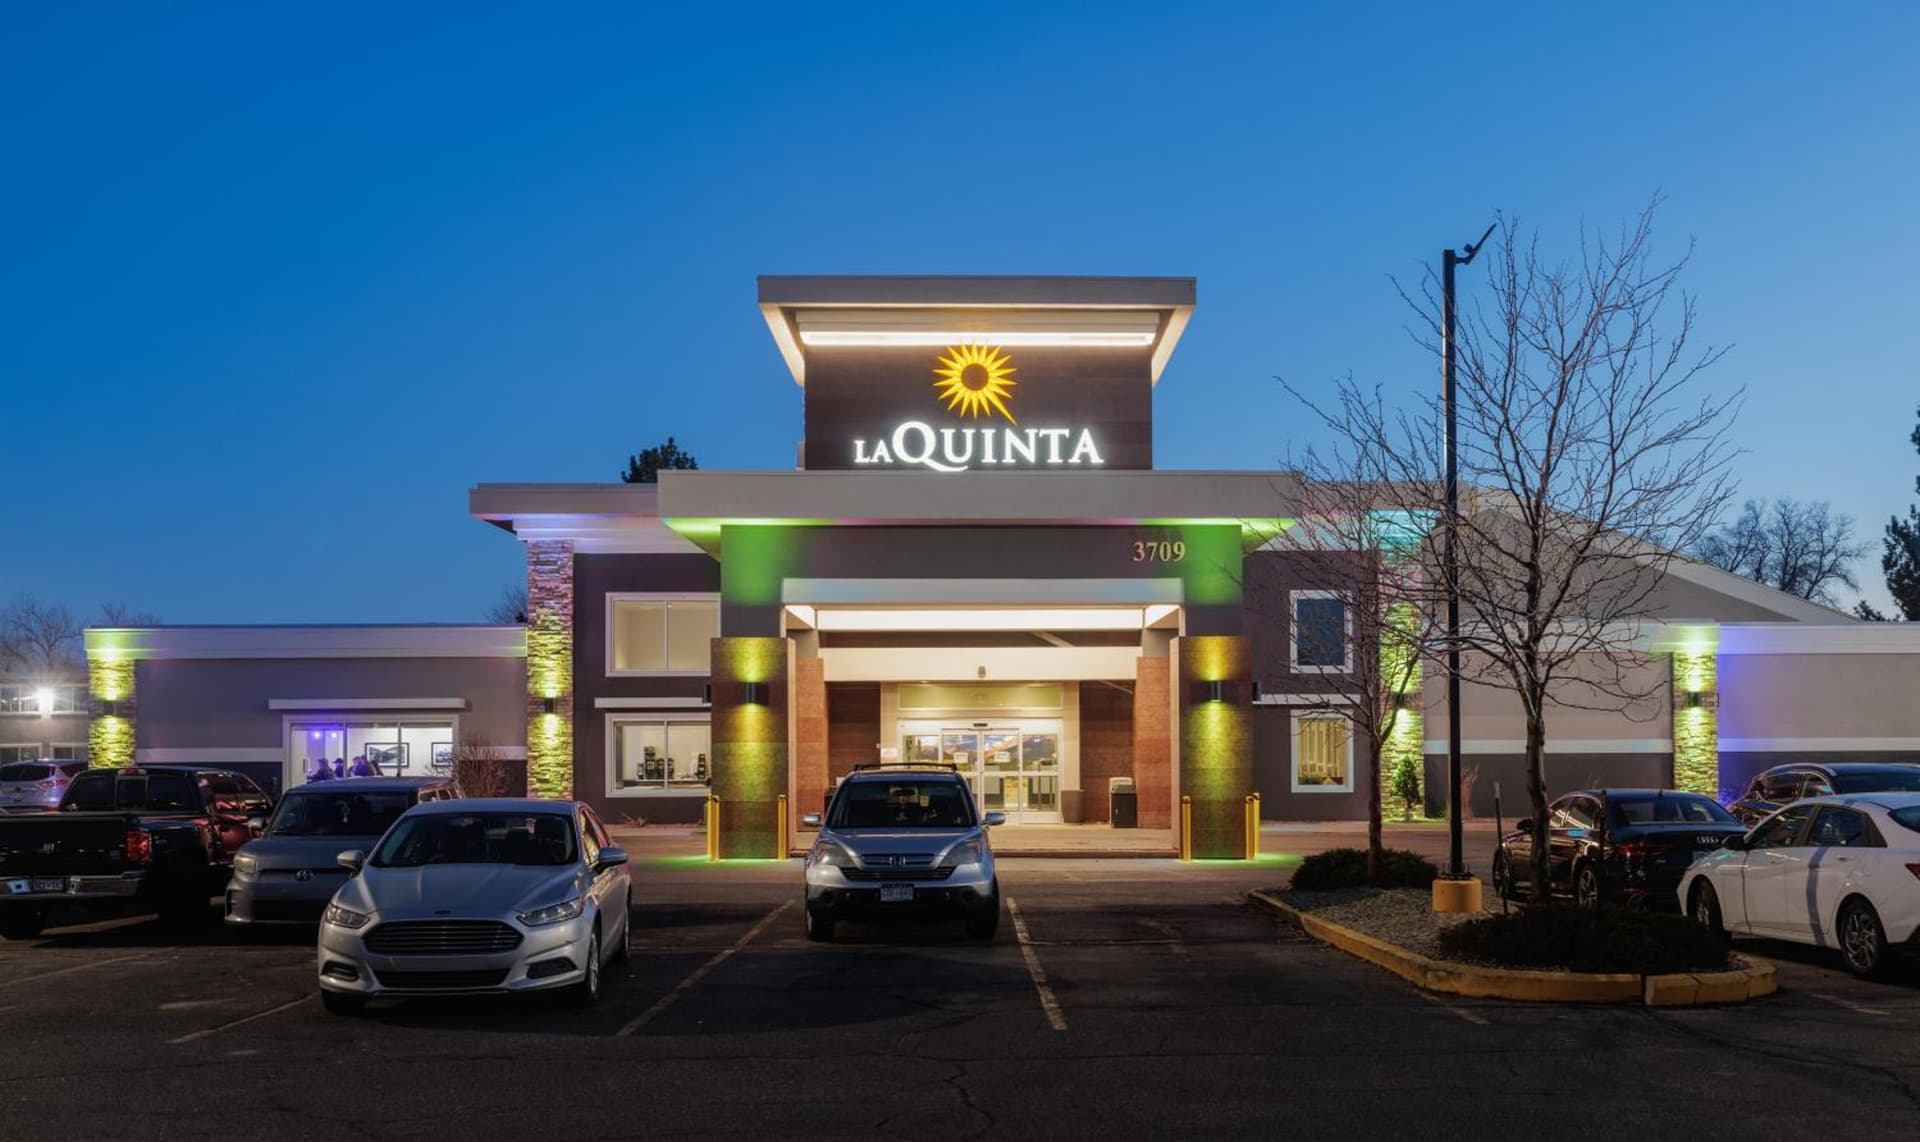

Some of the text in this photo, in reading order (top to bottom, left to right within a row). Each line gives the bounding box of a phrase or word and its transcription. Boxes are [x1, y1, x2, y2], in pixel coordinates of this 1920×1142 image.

[854, 421, 1104, 472] LA QUINTA
[1133, 541, 1185, 562] 3709
